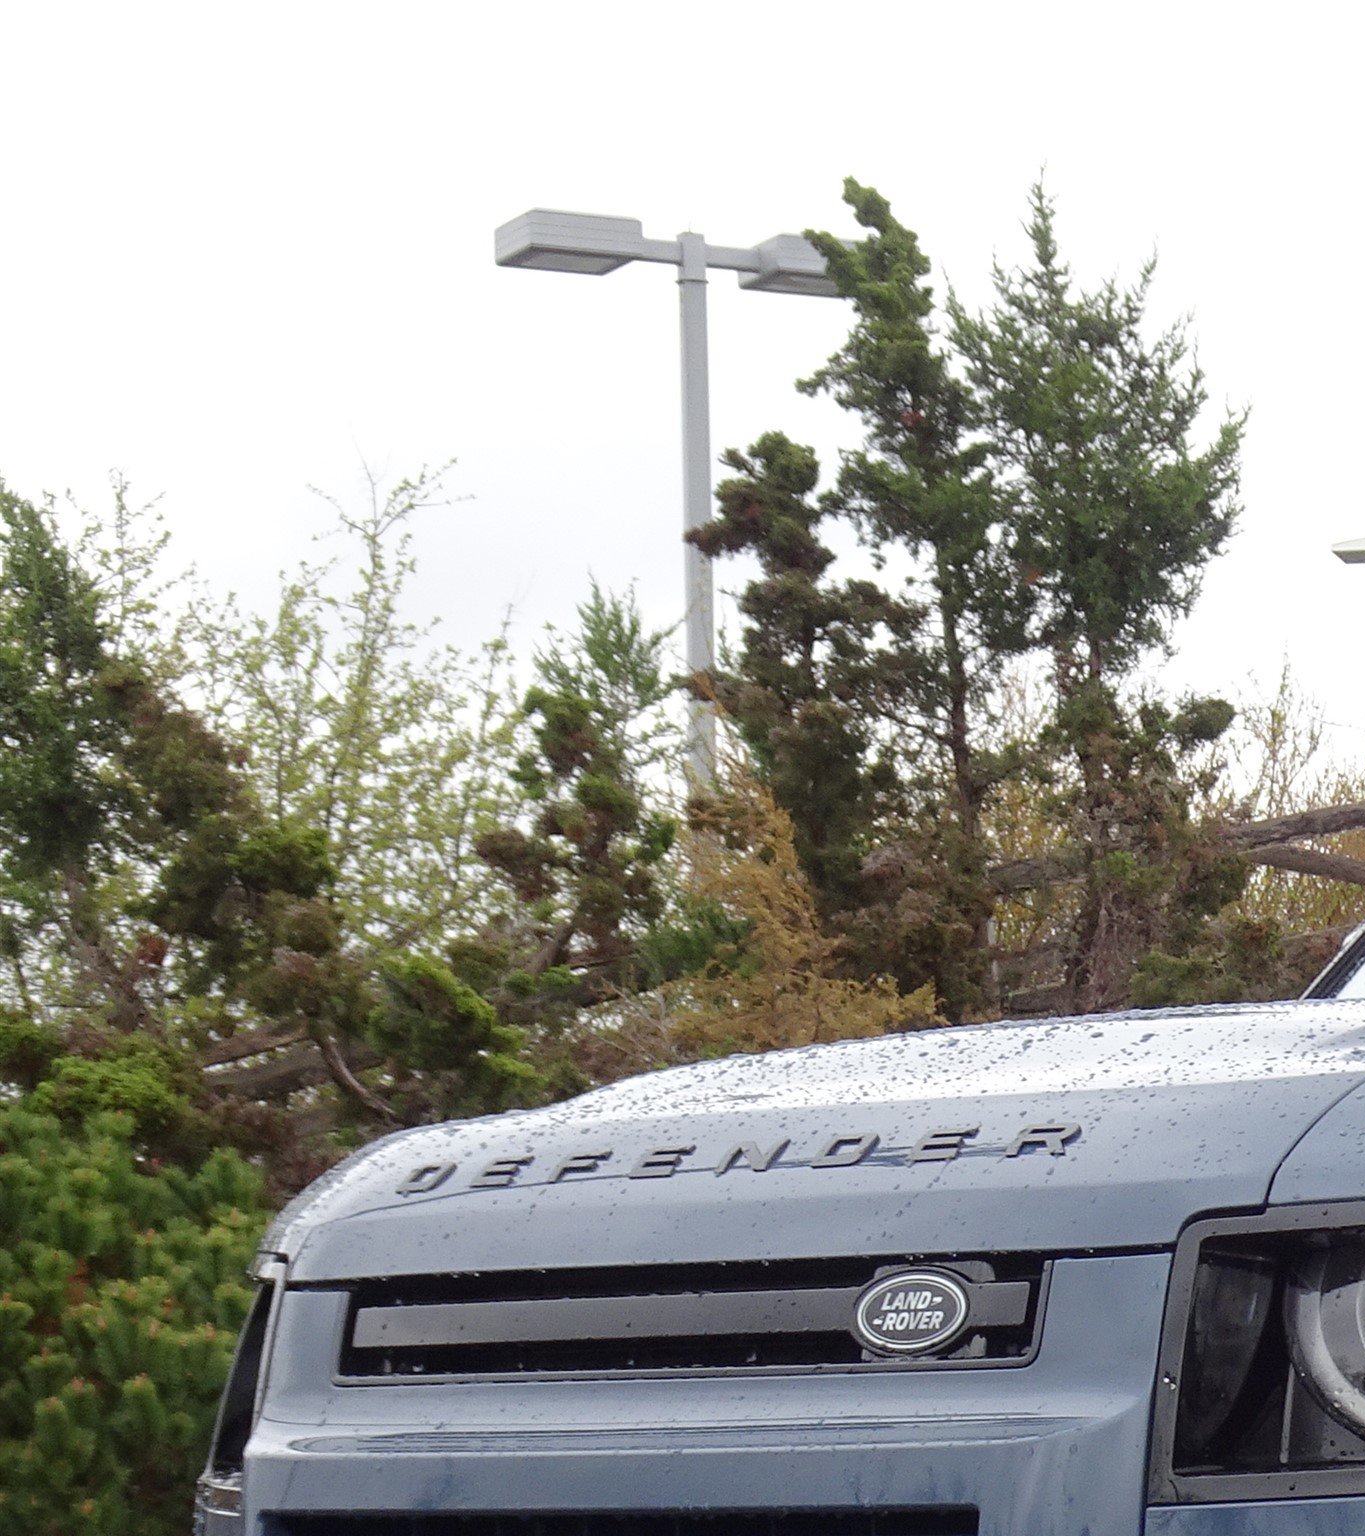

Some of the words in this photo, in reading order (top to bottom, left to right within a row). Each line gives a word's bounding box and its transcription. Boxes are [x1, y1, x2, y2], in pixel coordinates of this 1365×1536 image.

[395, 1122, 1082, 1195] DEFENDER
[881, 1291, 932, 1311] LAND
[882, 1311, 944, 1331] ROVER
